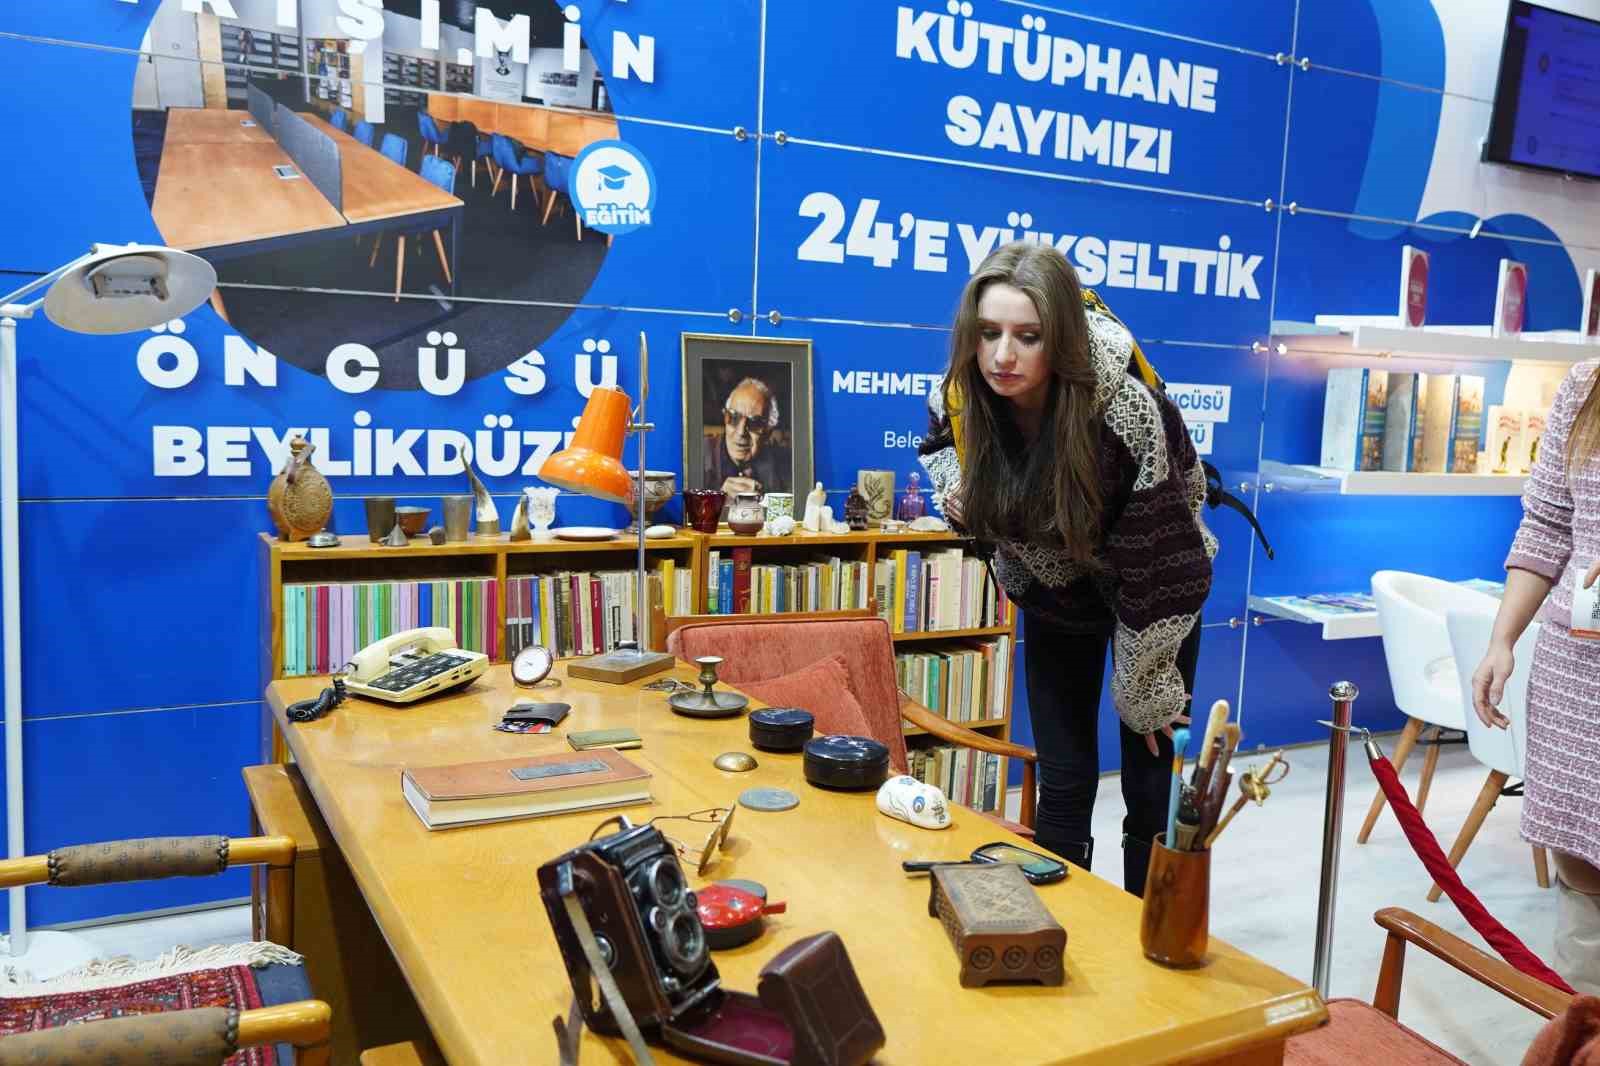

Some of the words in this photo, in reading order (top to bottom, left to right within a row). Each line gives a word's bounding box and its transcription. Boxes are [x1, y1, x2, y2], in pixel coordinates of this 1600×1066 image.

[896, 0, 1218, 113] KÜTÜPHANE
[944, 95, 1173, 175] SAYIMIZI
[585, 202, 651, 225] EĞİTİM
[956, 211, 1264, 300] YSELTTİK
[136, 318, 618, 399] ÖNCÜSÜ
[152, 410, 582, 477] BEYLİKDÜZ
